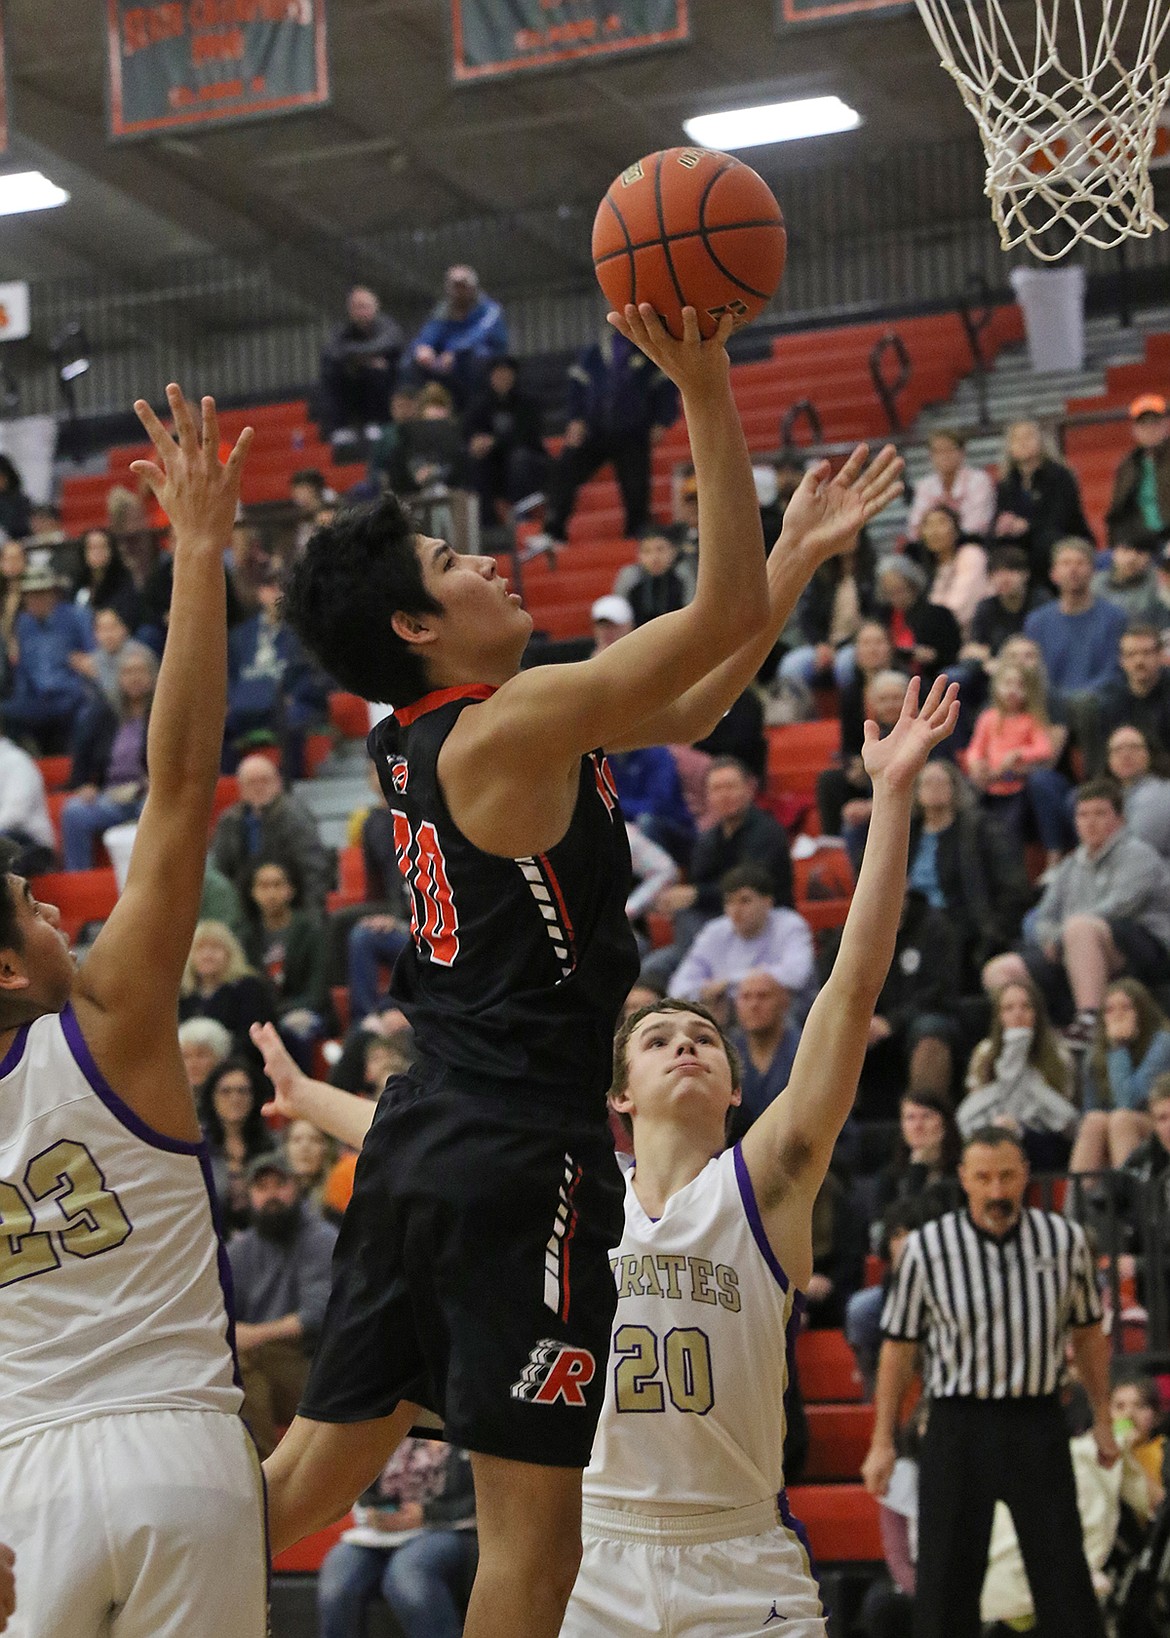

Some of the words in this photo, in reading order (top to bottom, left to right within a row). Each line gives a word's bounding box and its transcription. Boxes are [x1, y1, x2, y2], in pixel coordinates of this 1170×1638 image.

[0, 1138, 134, 1289] 23
[531, 1346, 597, 1407] R
[614, 1323, 715, 1416] 20
